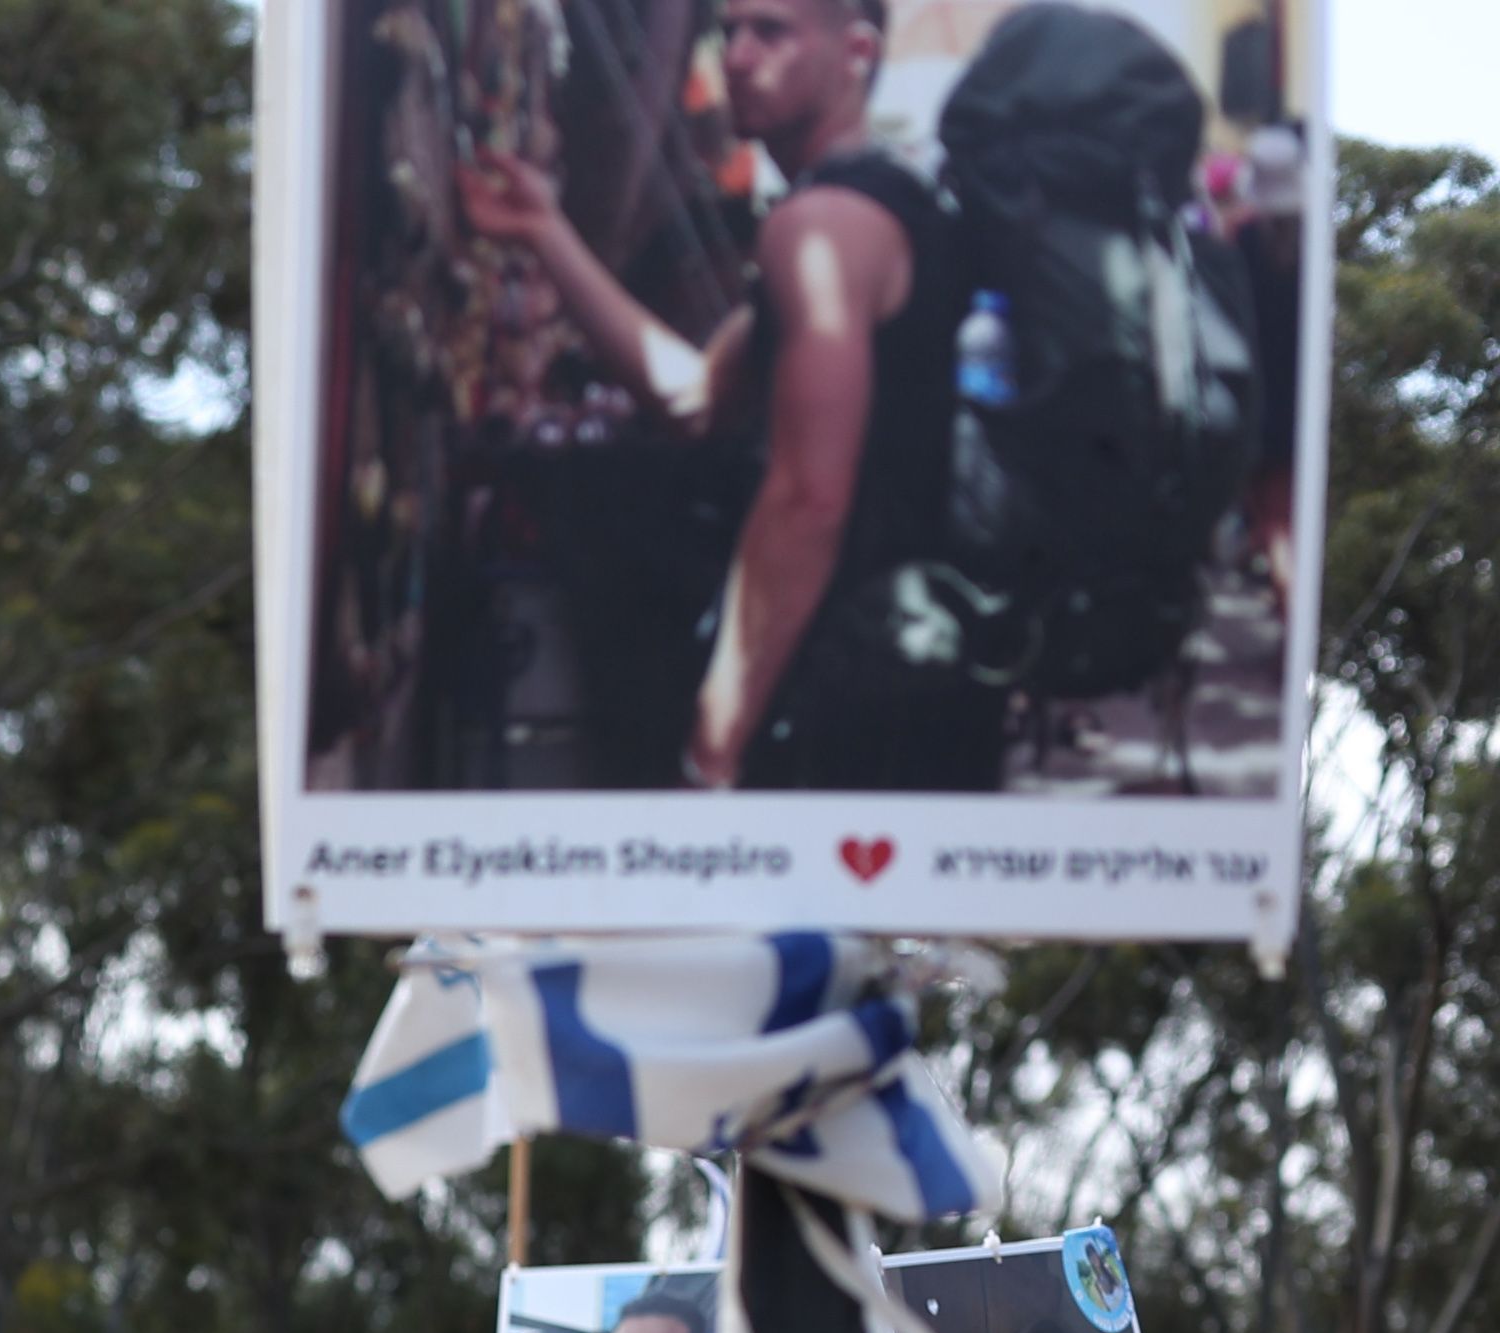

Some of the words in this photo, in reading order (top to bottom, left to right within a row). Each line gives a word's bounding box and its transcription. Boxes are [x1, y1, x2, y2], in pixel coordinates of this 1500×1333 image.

[306, 838, 408, 875] Aner
[423, 838, 606, 887] Elyakim
[618, 838, 792, 884] Shapiro
[933, 849, 1054, 880] שפירא
[1209, 850, 1269, 884] ענר
